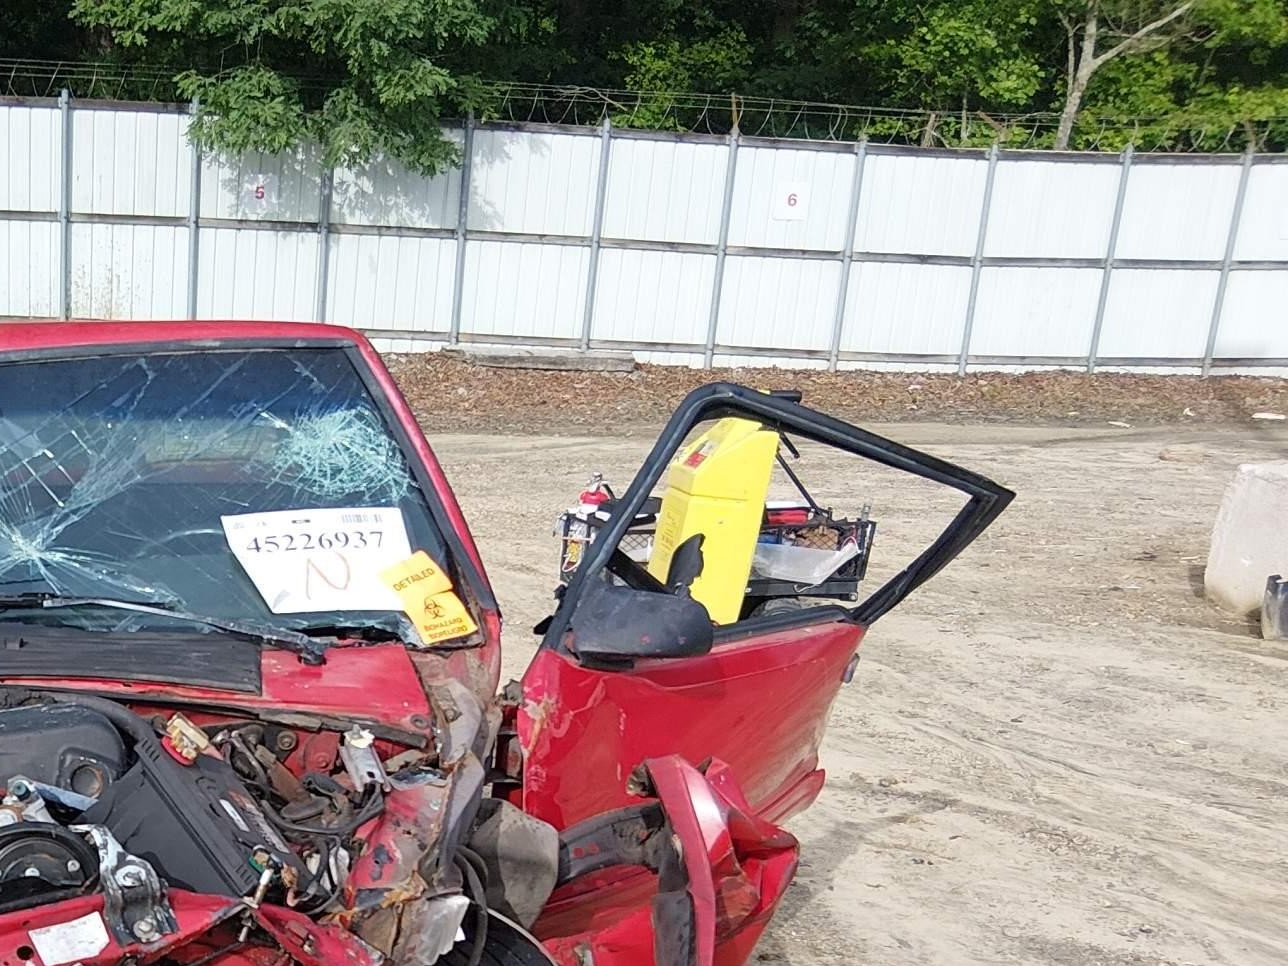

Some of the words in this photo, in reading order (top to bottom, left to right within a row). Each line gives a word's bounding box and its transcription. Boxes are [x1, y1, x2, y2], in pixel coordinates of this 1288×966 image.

[255, 185, 265, 200] 5
[787, 192, 798, 207] 6
[246, 531, 384, 553] 45226937
[304, 549, 352, 600] N
[392, 567, 436, 592] DETAILED
